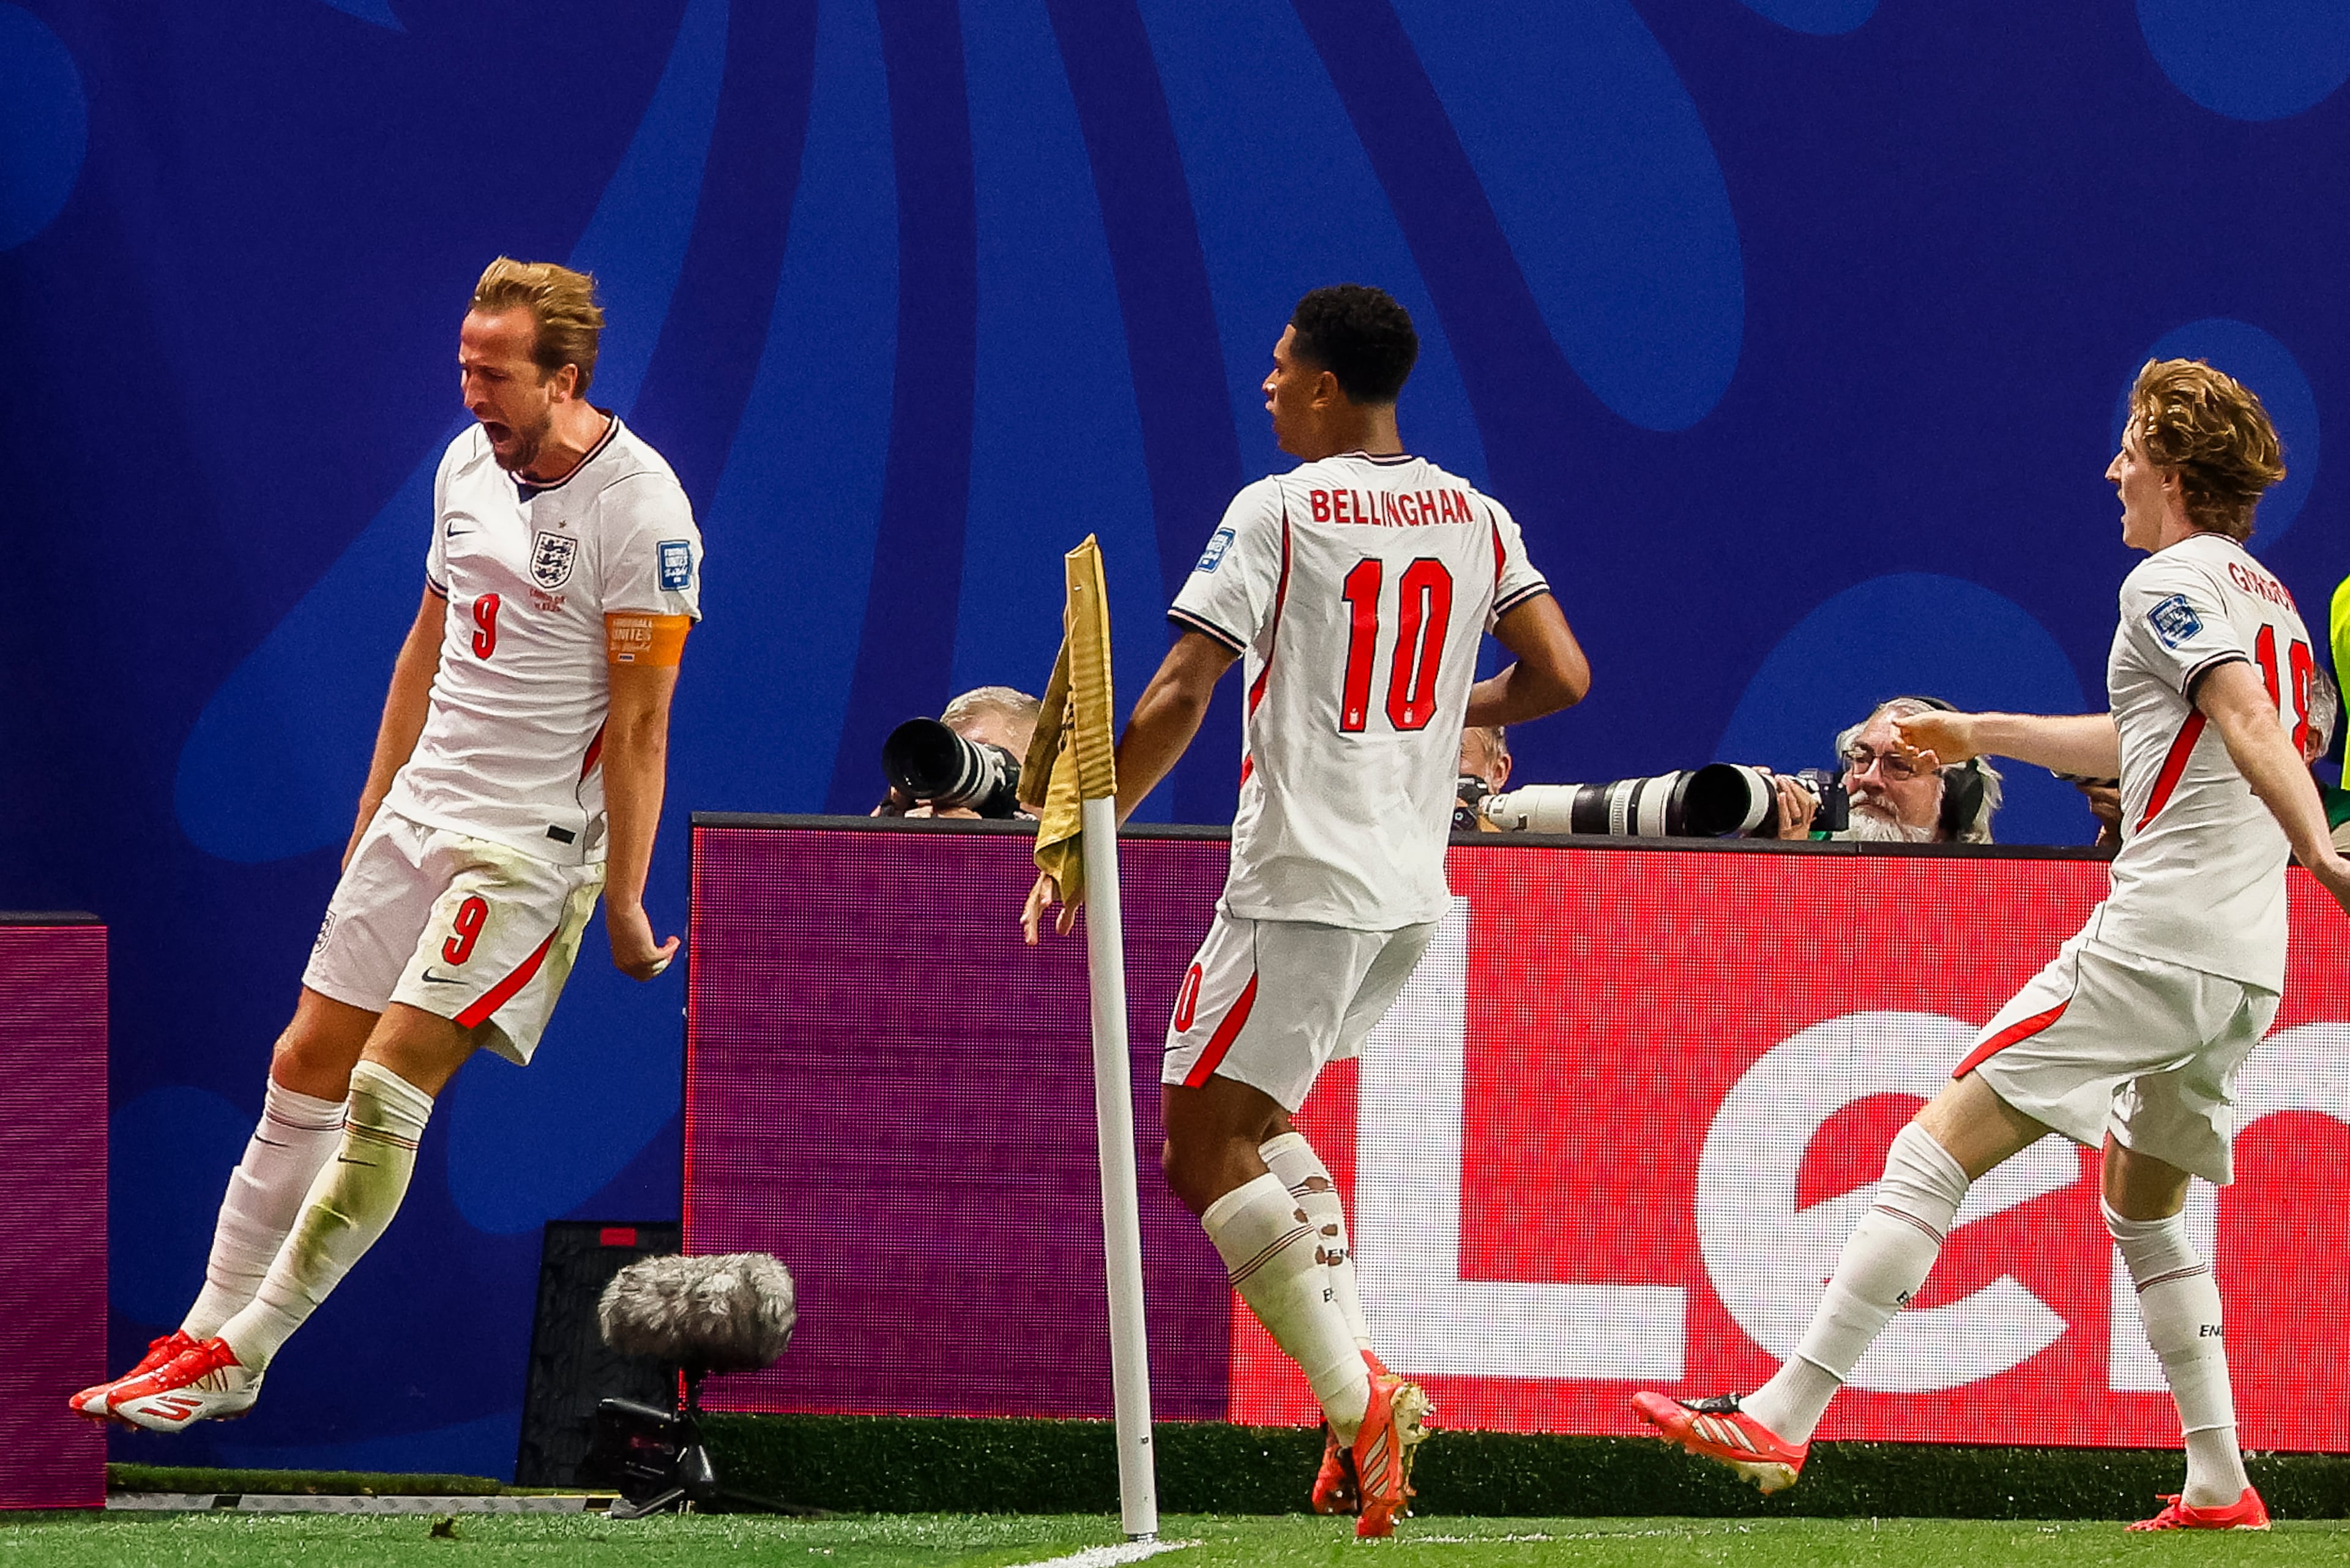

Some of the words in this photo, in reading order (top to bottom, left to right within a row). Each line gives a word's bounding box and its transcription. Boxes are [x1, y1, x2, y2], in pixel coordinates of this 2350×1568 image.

[472, 592, 501, 660] 9
[1339, 557, 1453, 733] 10
[442, 895, 489, 966] 9
[1174, 961, 1203, 1033] 0
